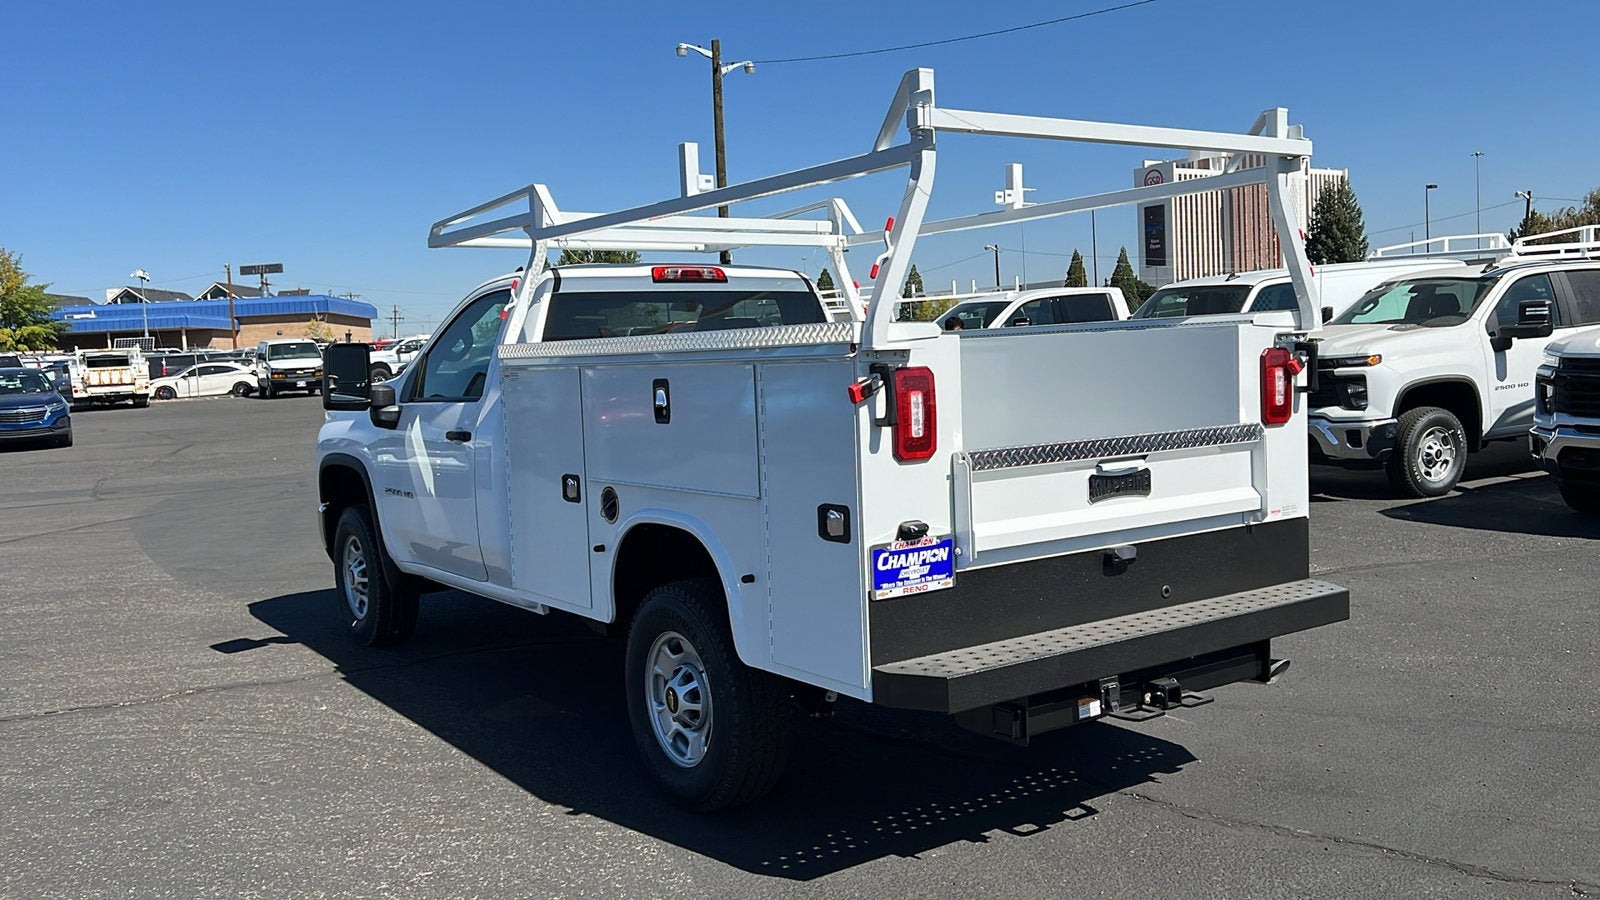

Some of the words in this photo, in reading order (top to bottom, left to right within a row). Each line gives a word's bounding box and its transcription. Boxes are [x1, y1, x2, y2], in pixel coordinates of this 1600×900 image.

[1147, 175, 1161, 187] GSR
[894, 538, 934, 549] CHAMPION
[877, 547, 949, 571] CHAMPION
[901, 567, 928, 577] CHEVROLET
[902, 584, 929, 595] RENO
